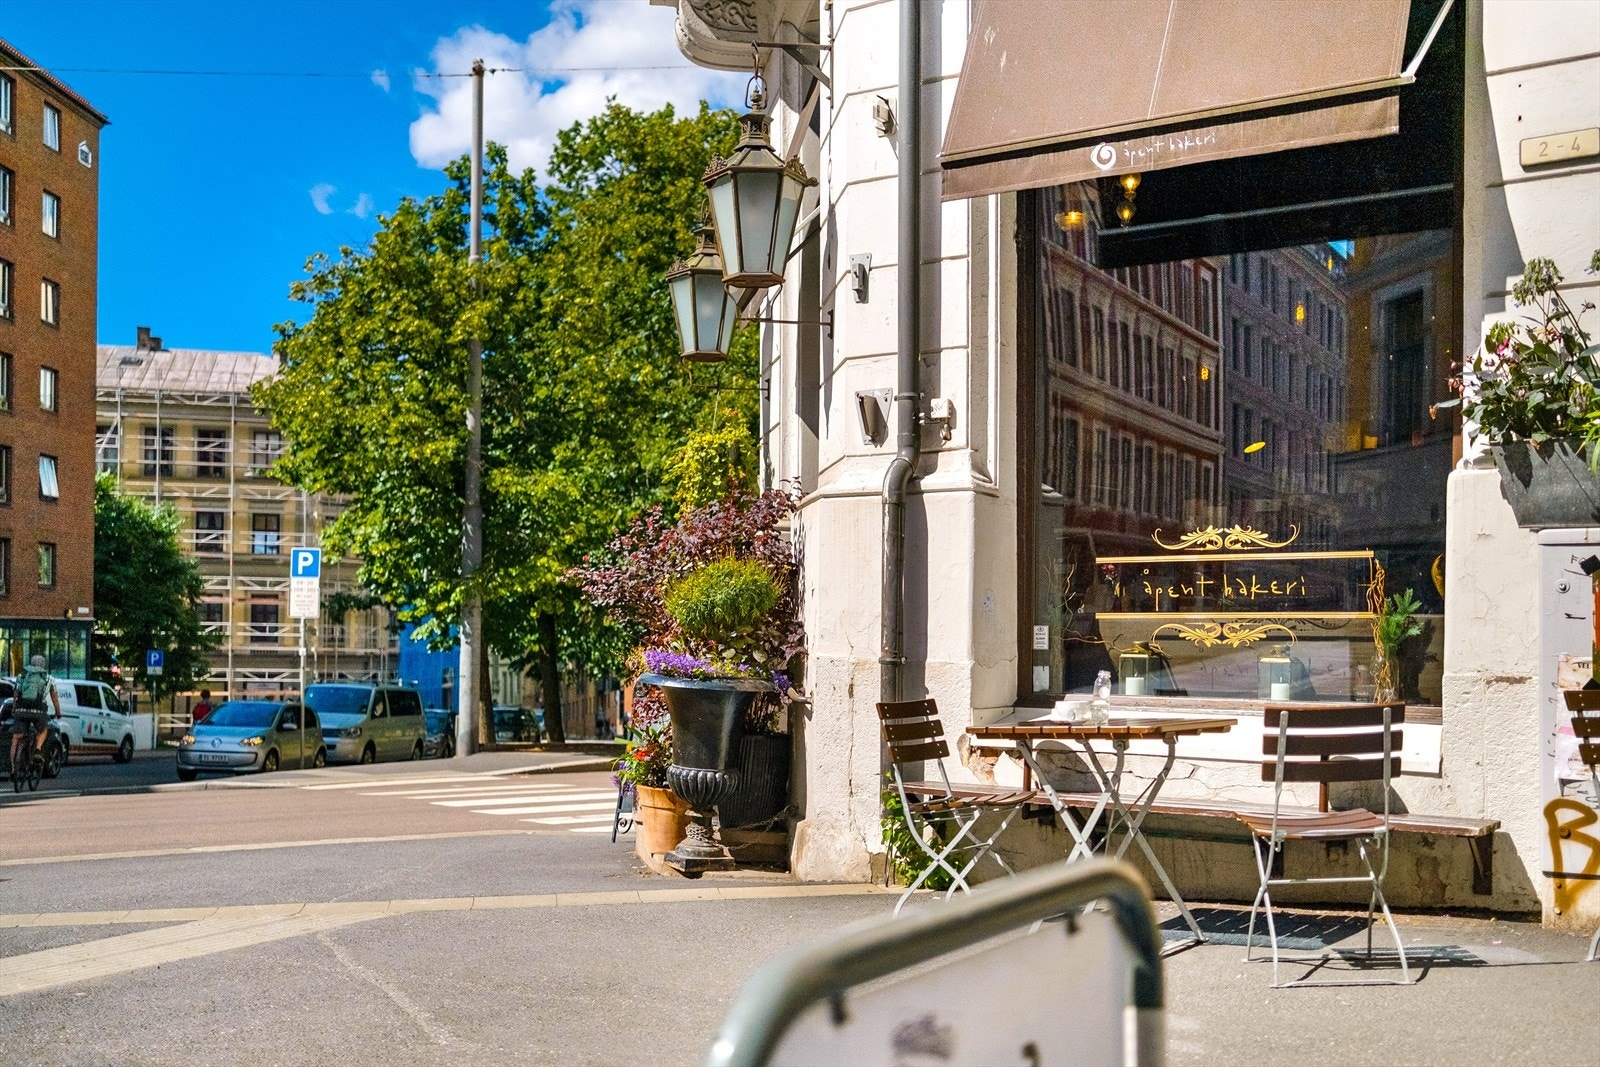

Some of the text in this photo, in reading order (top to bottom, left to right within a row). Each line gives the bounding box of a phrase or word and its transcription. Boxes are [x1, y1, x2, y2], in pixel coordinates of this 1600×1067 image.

[1124, 130, 1216, 166] åpent bakeri
[1539, 141, 1549, 158] 2
[1571, 136, 1581, 152] 4
[297, 551, 314, 575] P
[1143, 568, 1306, 612] åpent bakeri
[151, 651, 159, 665] P
